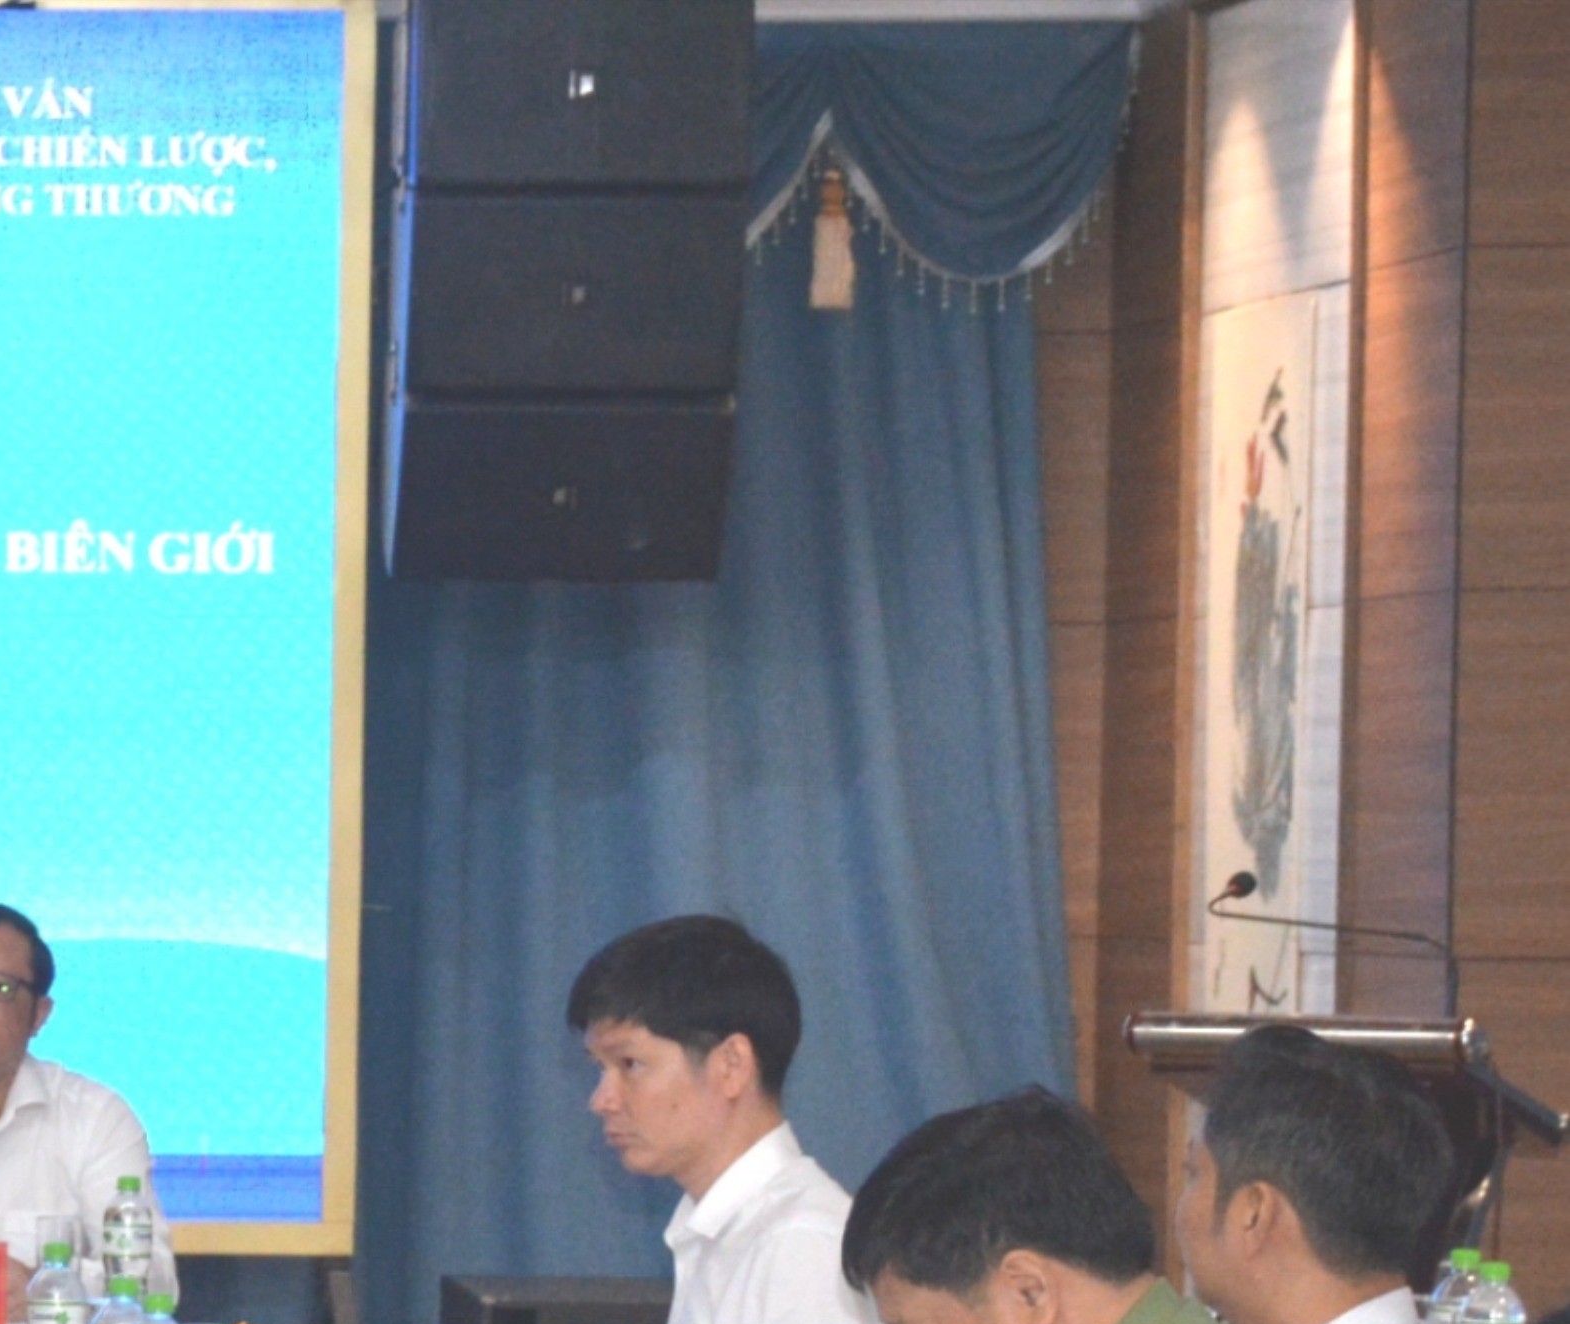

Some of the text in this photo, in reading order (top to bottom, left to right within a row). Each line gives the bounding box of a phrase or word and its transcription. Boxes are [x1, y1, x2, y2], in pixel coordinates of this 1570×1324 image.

[139, 130, 277, 177] LƯỢC,
[43, 179, 236, 217] THƯƠNG
[5, 518, 136, 574] BIÊN
[147, 520, 274, 575] GIỚI
